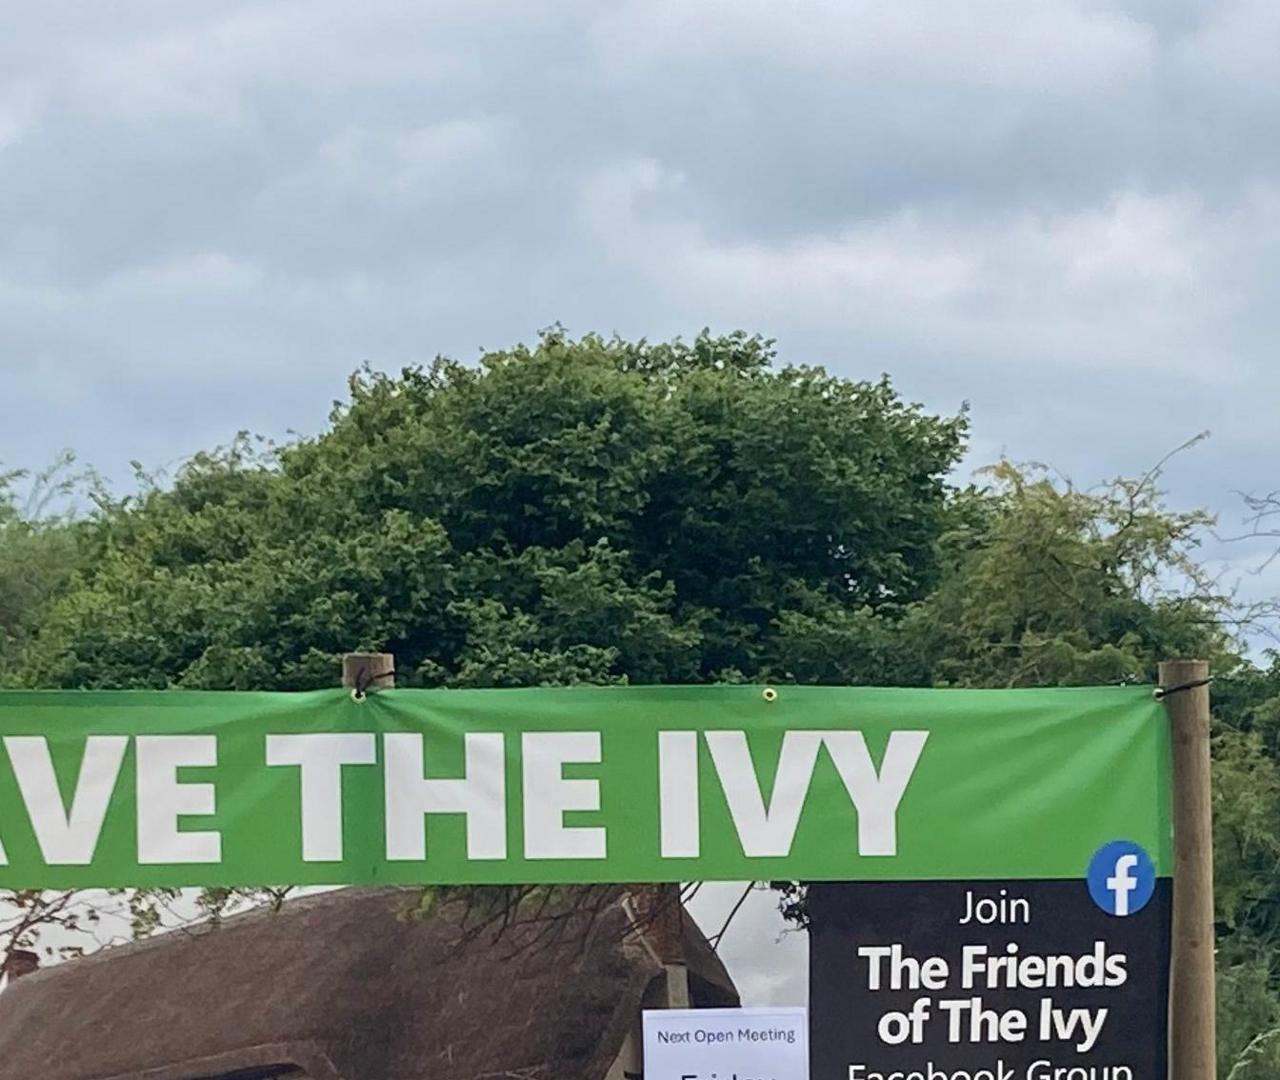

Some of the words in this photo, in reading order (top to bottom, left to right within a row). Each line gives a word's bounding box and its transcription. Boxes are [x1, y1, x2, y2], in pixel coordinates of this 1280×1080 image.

[265, 731, 607, 862] THE
[659, 730, 930, 858] IVY
[959, 889, 1030, 924] Join
[858, 944, 949, 990] The
[962, 941, 1128, 989] Friends
[657, 1030, 690, 1044] Next
[695, 1029, 734, 1044] Open
[738, 1028, 796, 1043] Meeting
[878, 998, 931, 1044] of
[939, 997, 1027, 1043] The
[1039, 998, 1108, 1053] Ivy
